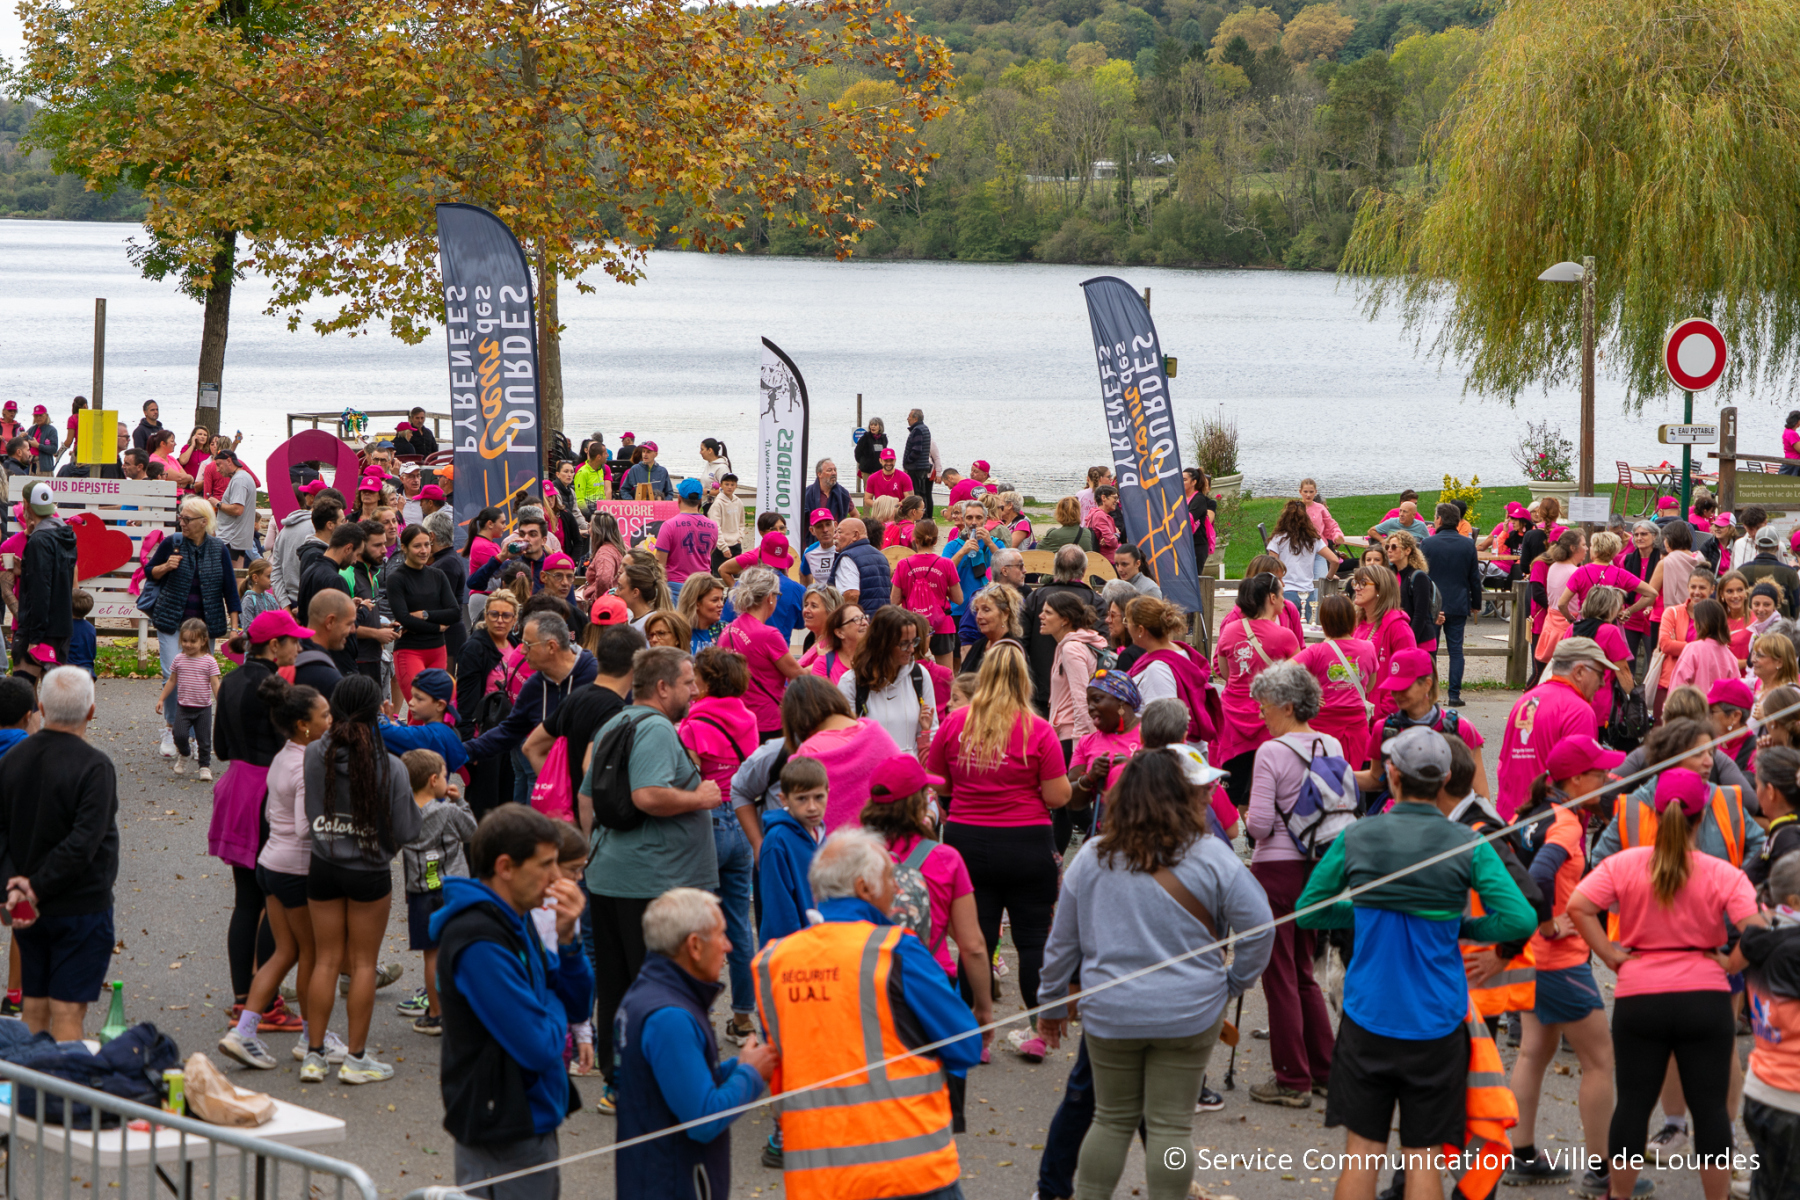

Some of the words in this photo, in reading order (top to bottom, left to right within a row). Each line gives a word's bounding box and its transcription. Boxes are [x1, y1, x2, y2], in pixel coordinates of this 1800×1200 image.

[71, 479, 120, 494] DÉPISTÉE
[601, 504, 654, 516] OCTOBRE
[616, 517, 655, 538] OSE
[696, 520, 715, 529] Arcs
[682, 531, 711, 554] 45
[98, 605, 114, 615] et
[117, 604, 136, 615] toi
[782, 967, 840, 985] SÉCURITÉ
